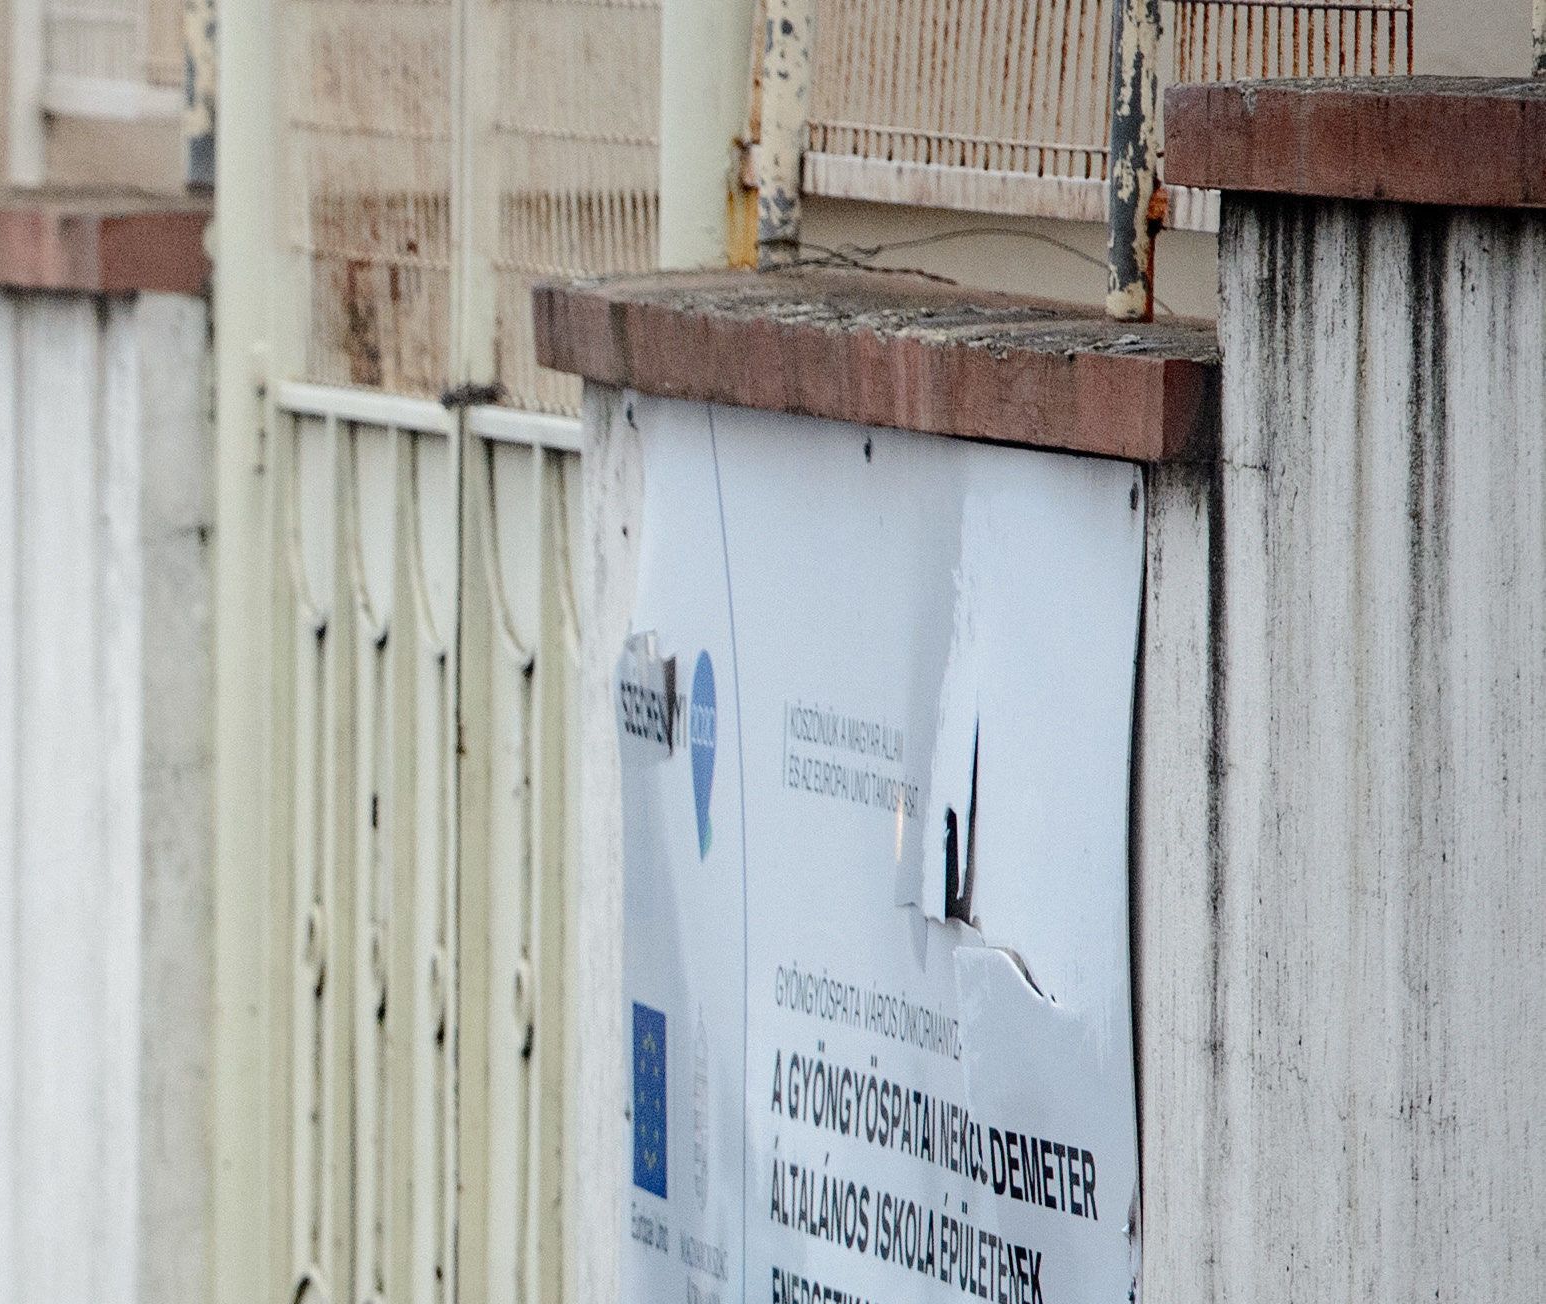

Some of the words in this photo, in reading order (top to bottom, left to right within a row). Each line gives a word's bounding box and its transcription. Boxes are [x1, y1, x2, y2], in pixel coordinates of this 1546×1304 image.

[775, 960, 861, 1028] GYÖNGYÖSPATA
[863, 980, 897, 1039] VÁROS
[770, 1048, 783, 1114] A
[788, 1039, 936, 1164] GYÖNGYÖSPATAI
[988, 1126, 1099, 1221] DEMETER
[769, 1134, 870, 1254] ÁLTALÁNOS
[874, 1190, 936, 1279] ISKOLA
